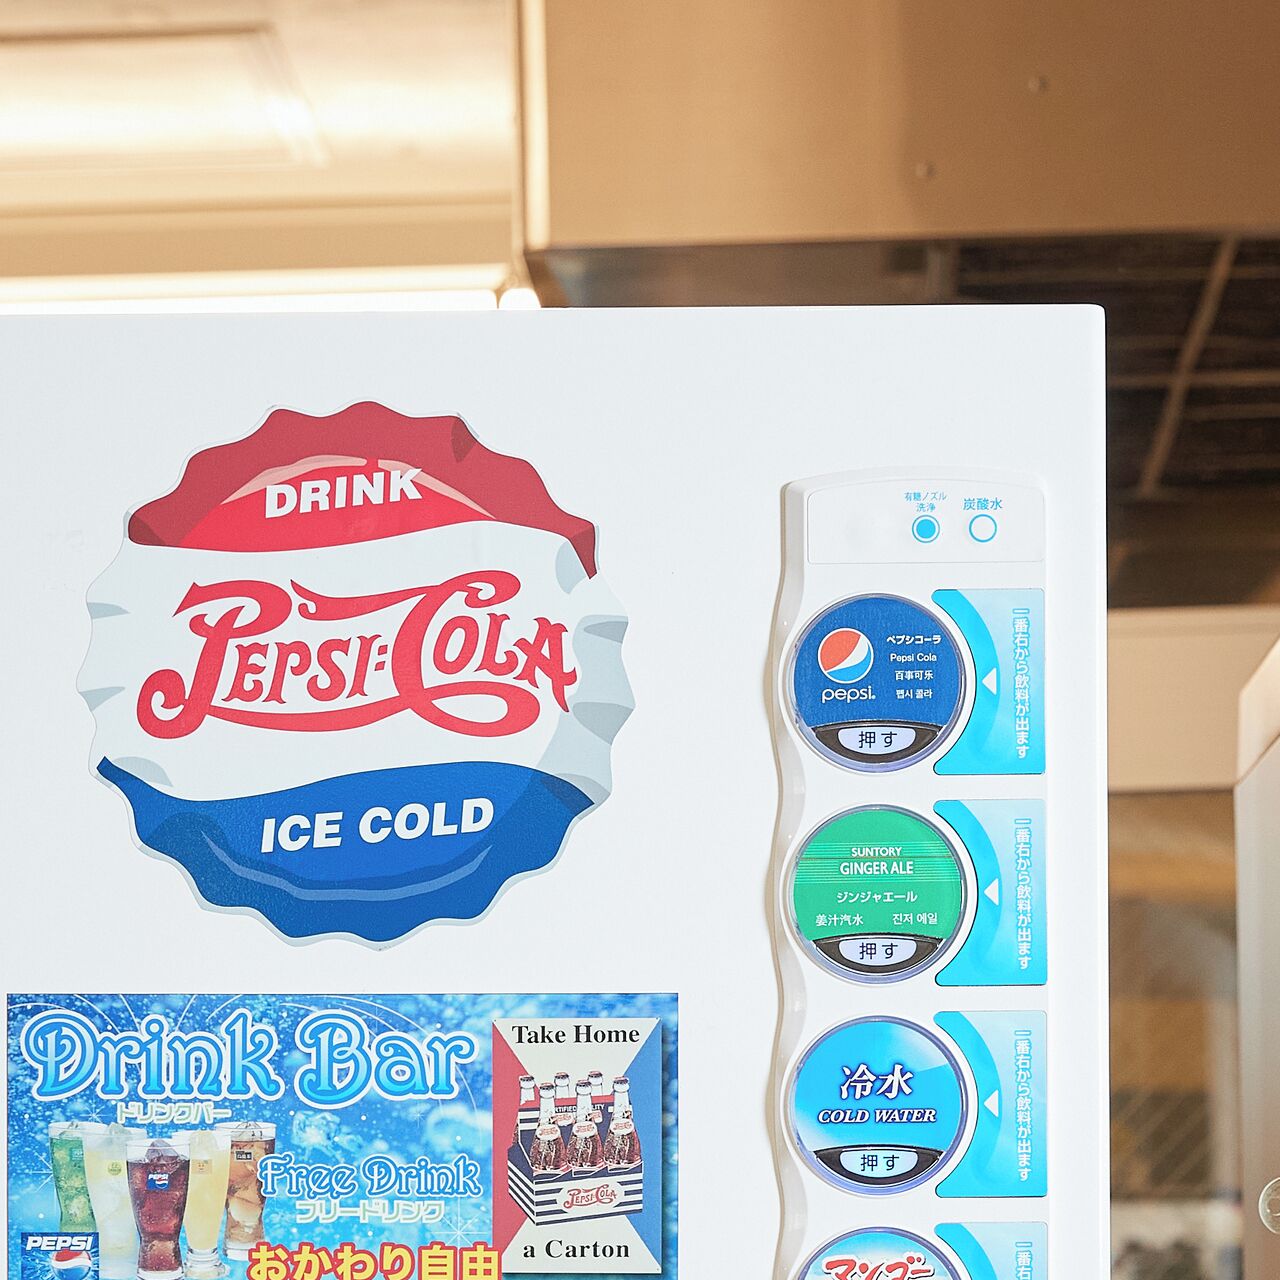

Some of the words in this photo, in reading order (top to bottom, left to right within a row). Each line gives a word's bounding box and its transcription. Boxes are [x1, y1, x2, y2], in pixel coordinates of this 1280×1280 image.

[265, 467, 423, 519] DRINK
[963, 497, 1003, 510] 炭酸水
[886, 634, 941, 645] ペプシコーラ
[890, 653, 914, 663] Pepsi
[916, 652, 937, 662] Cola
[1013, 607, 1030, 759] 一番右から飲料が出ます
[858, 731, 897, 749] 押す
[261, 811, 344, 853] ICE
[358, 796, 494, 844] COLD
[851, 846, 902, 857] SUNTORY
[839, 861, 889, 876] GINGER
[890, 861, 914, 875] ALE
[836, 891, 918, 903] ジンジャエール
[1014, 818, 1031, 970] 一番右から飲料が出ます
[859, 942, 898, 960] 押す
[512, 1025, 566, 1044] Take
[573, 1024, 640, 1043] Home
[22, 1010, 284, 1099] Drink
[296, 1010, 477, 1107] Bar
[839, 1063, 914, 1100] 冷水
[117, 1102, 232, 1124] ドリンクバー
[1014, 1029, 1031, 1181] 一番右から飲料が出ます
[817, 1108, 870, 1123] COLD
[874, 1108, 937, 1123] WATER
[860, 1154, 900, 1172] 押す
[258, 1153, 356, 1199] Free
[361, 1153, 482, 1197] Drink
[295, 1200, 445, 1223] フリードリンク
[25, 1235, 94, 1251] PEPSI
[523, 1244, 535, 1258] a
[545, 1238, 630, 1258] Carton
